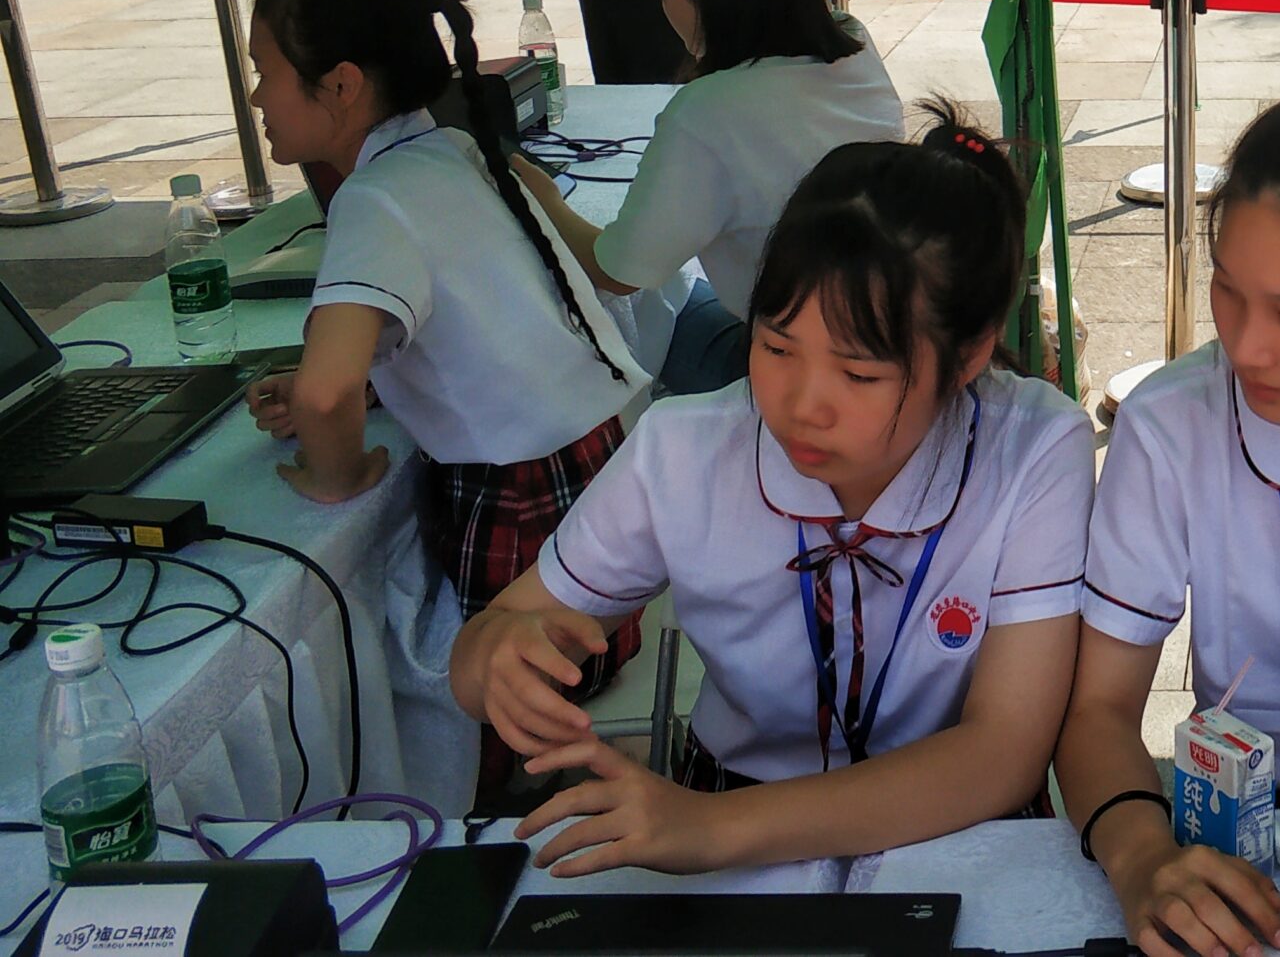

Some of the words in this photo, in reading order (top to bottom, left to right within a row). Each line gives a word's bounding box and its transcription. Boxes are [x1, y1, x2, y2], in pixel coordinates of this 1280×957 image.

[1184, 777, 1203, 839] 纯牛
[54, 931, 86, 946] 2019
[94, 925, 177, 942] 海口马拉松
